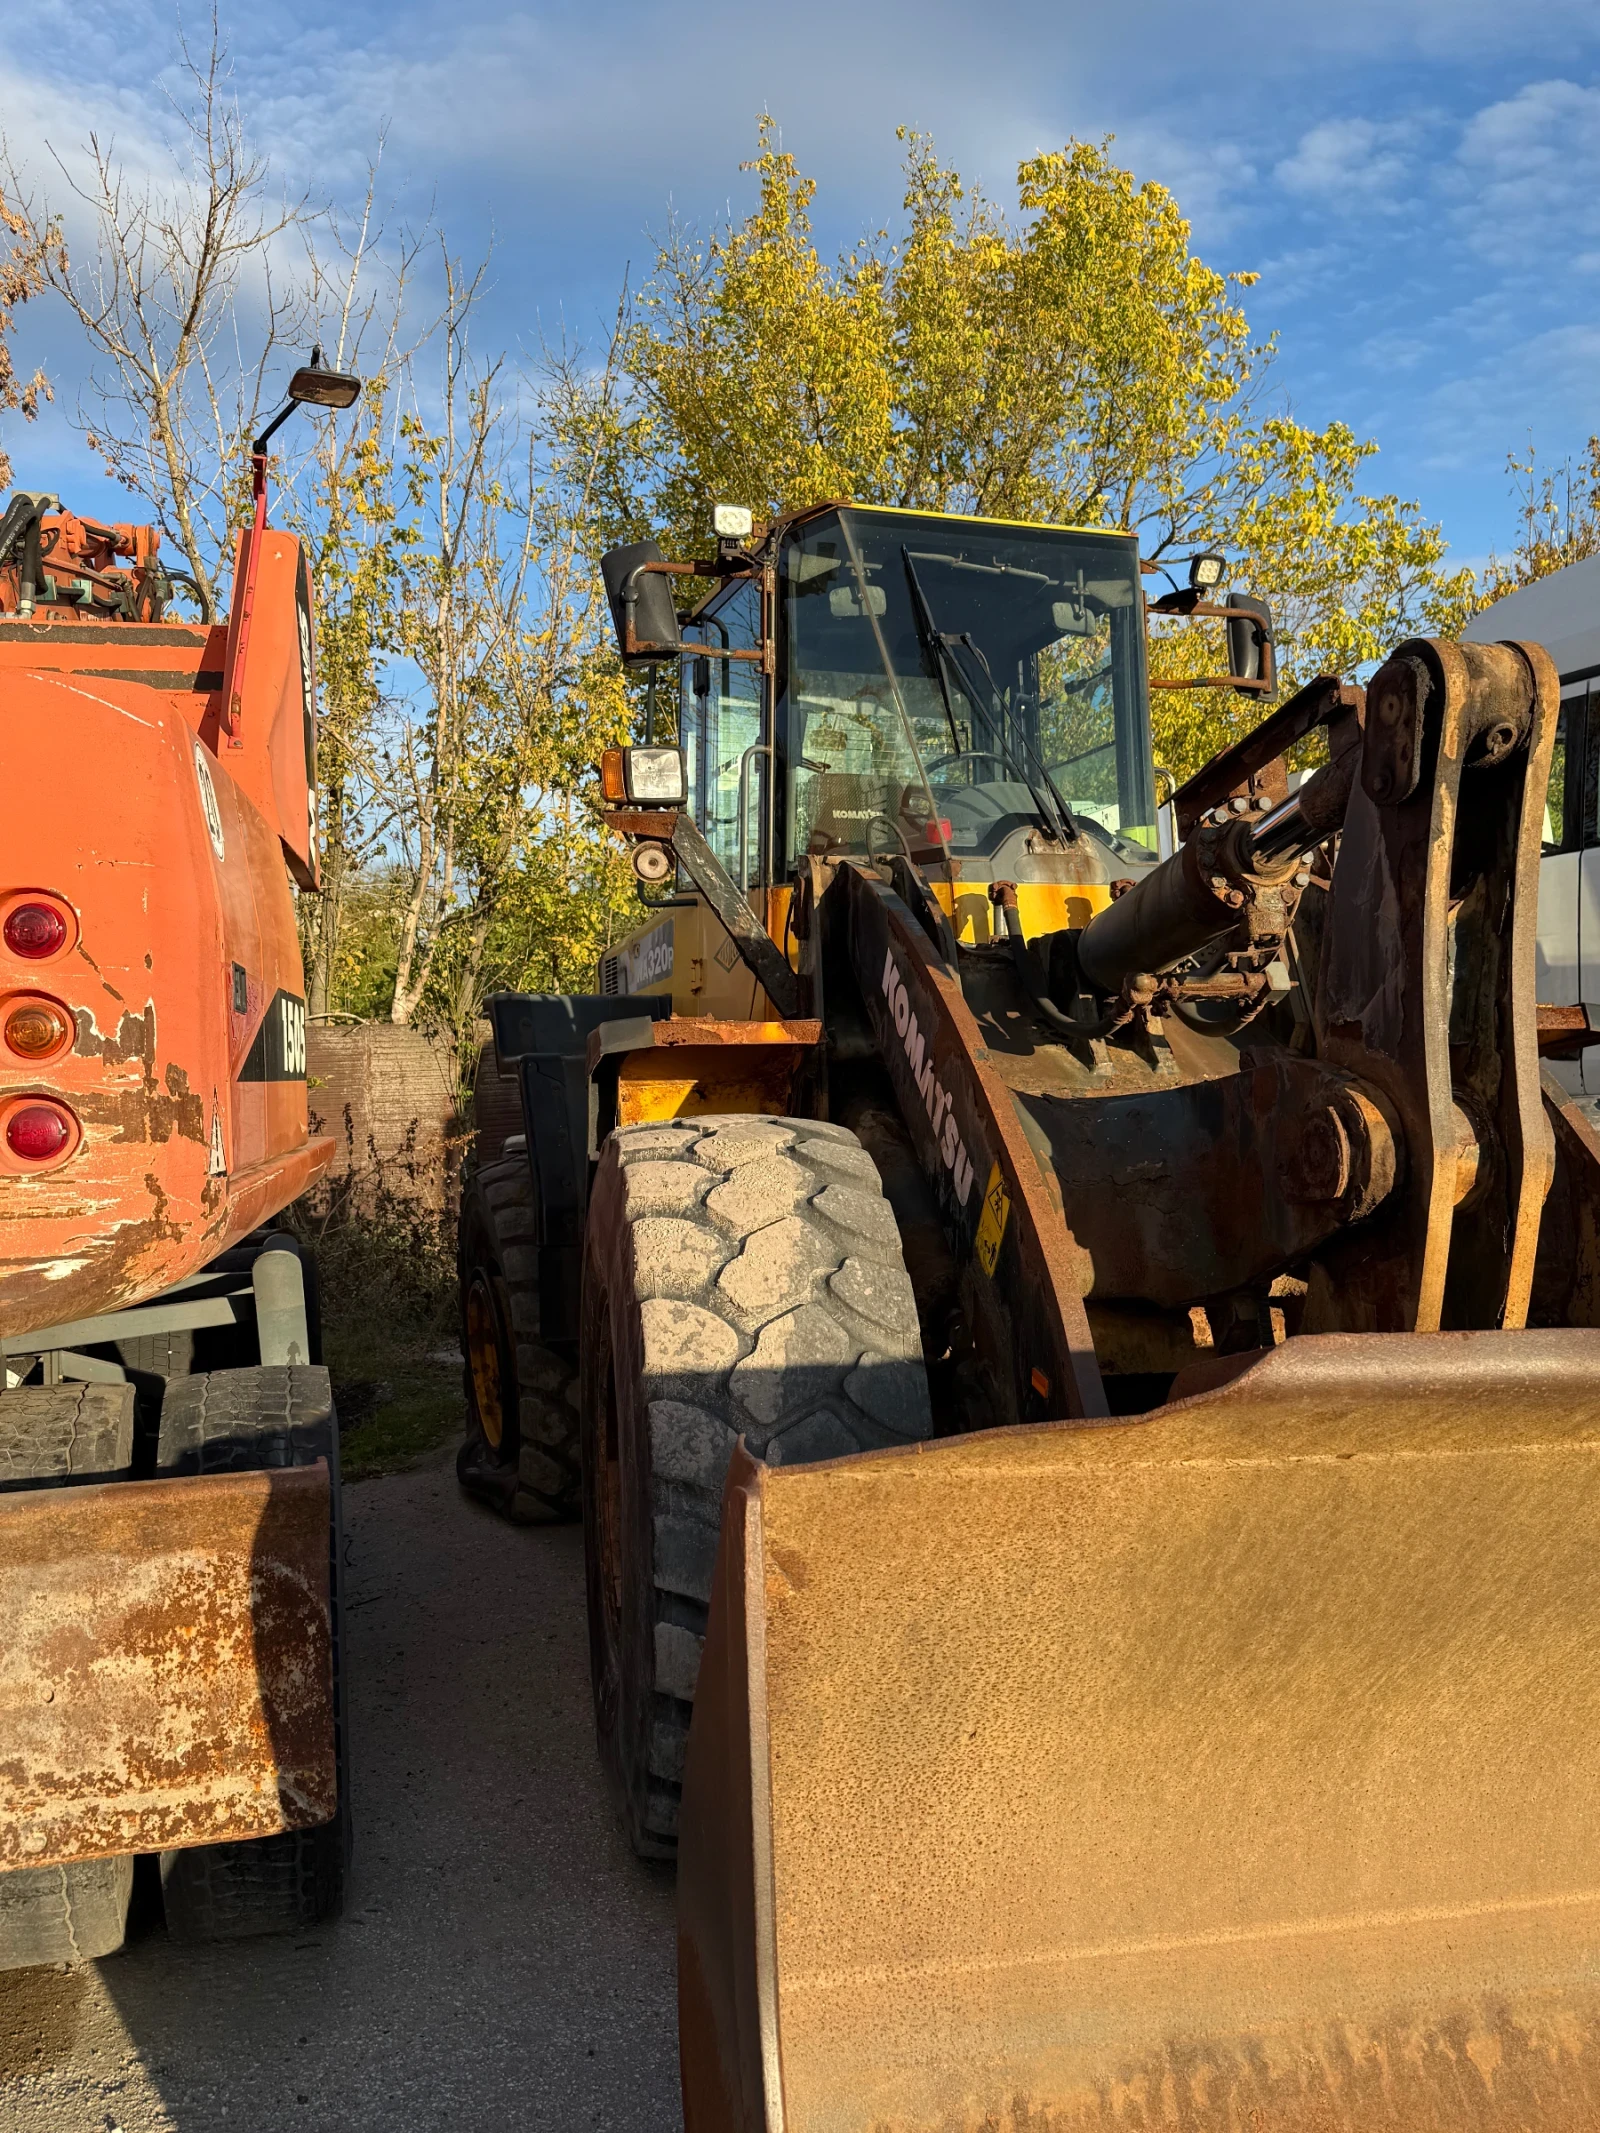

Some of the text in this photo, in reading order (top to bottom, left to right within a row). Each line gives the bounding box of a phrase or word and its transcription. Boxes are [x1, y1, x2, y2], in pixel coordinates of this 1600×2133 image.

[197, 760, 221, 842] 20
[281, 998, 306, 1074] 1505
[881, 947, 974, 1207] KOMATSU
